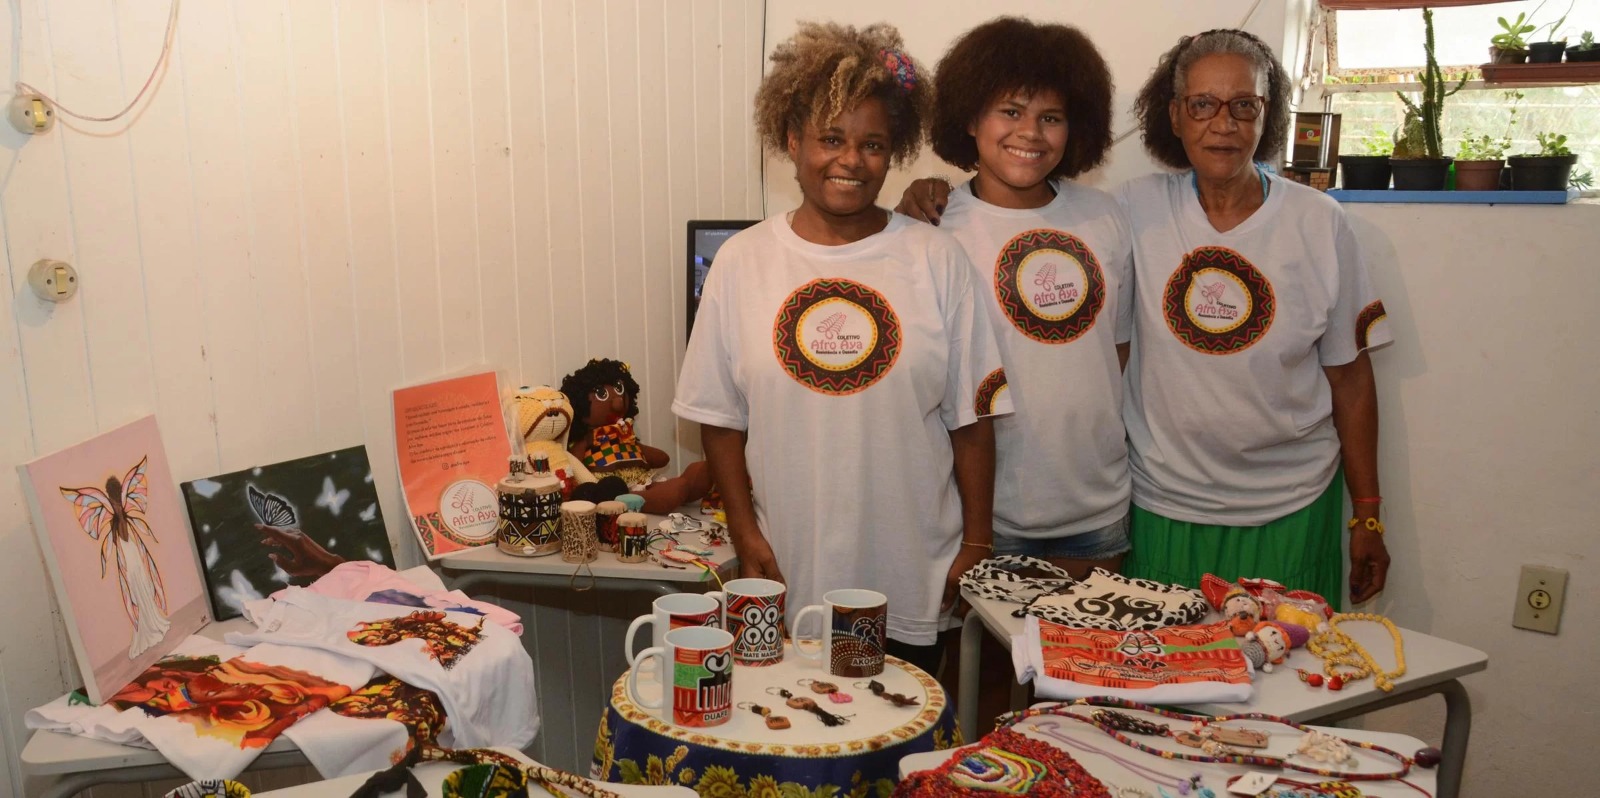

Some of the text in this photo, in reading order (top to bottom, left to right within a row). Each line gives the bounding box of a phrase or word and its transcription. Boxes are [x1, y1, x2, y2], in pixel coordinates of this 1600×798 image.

[1054, 282, 1074, 290] COLETIVO
[1034, 288, 1078, 304] Afro Aya
[1195, 304, 1238, 317] Afro Aya
[811, 339, 863, 350] Afro Aya
[452, 515, 475, 526] Afro
[477, 510, 497, 521] Aya
[1123, 658, 1167, 669] AYA
